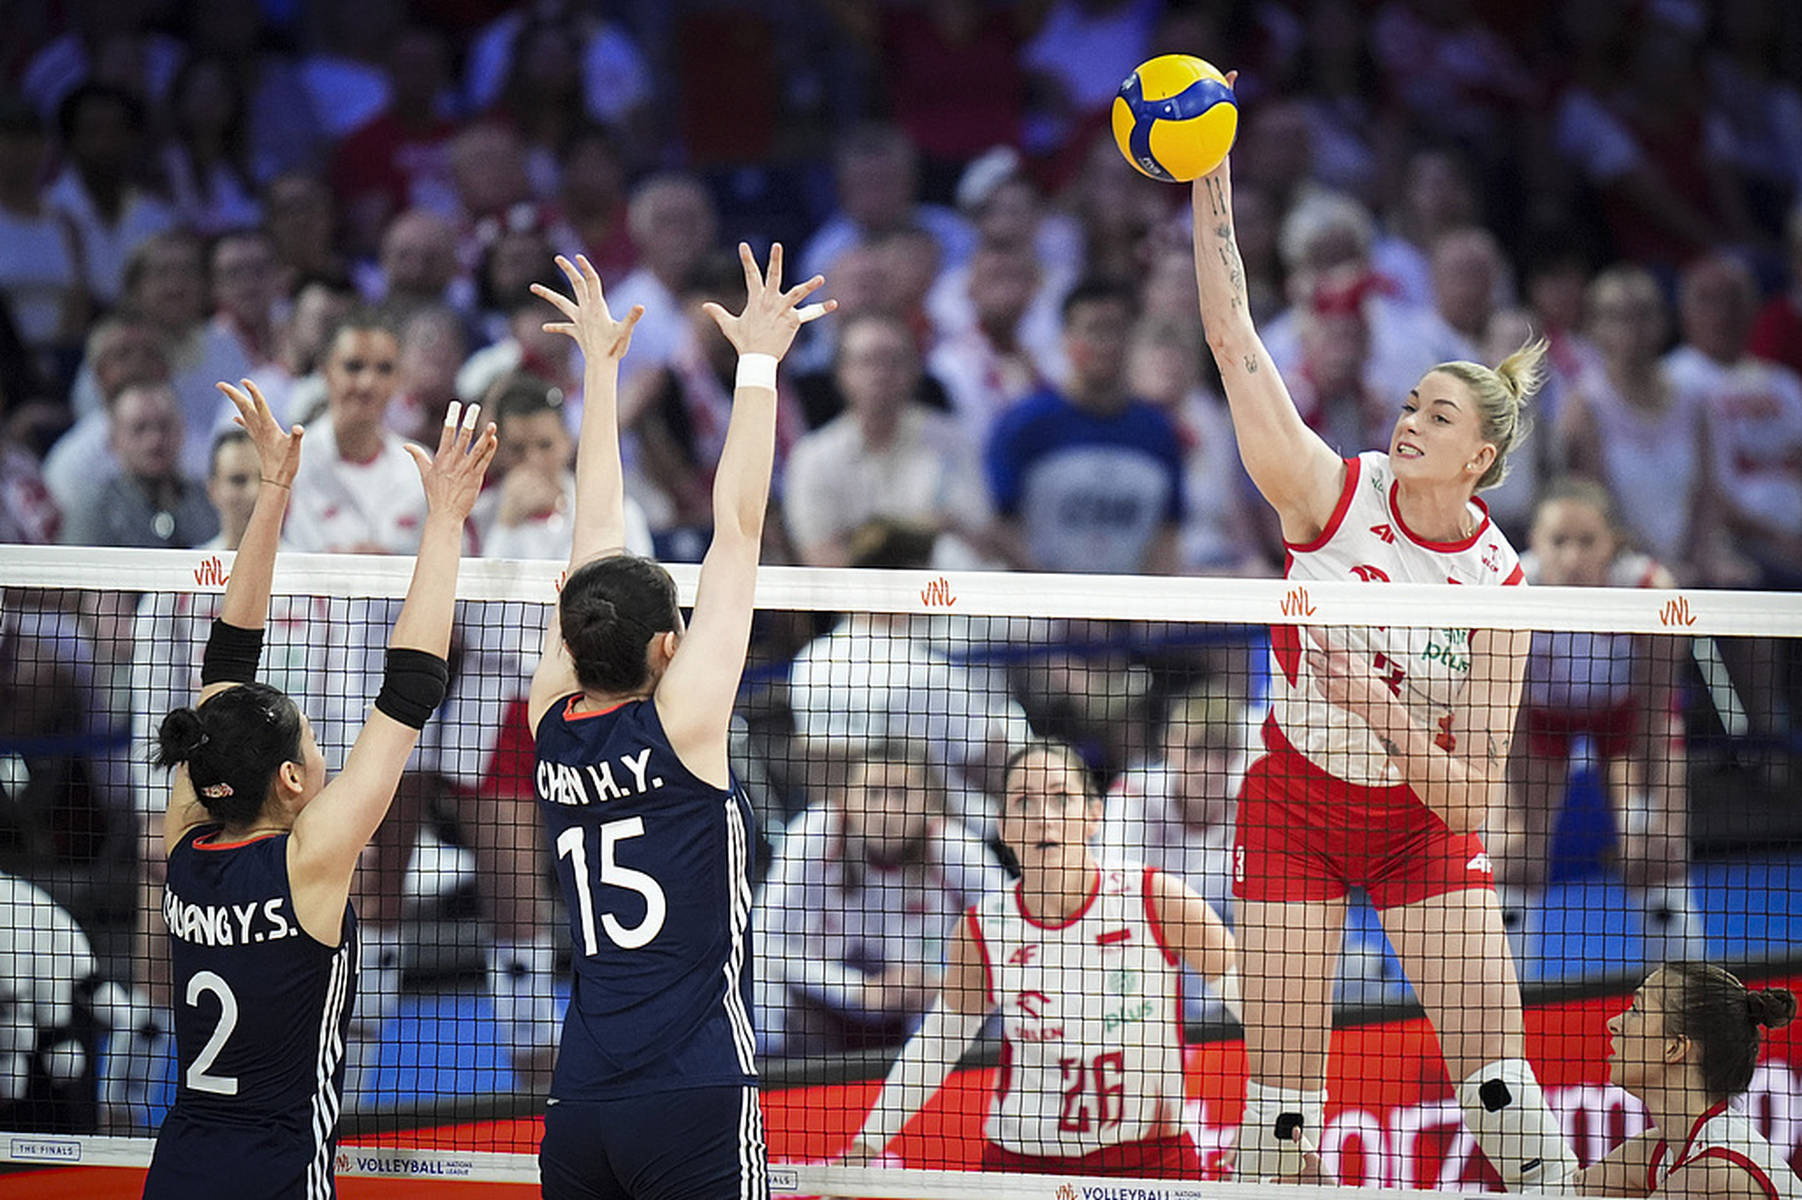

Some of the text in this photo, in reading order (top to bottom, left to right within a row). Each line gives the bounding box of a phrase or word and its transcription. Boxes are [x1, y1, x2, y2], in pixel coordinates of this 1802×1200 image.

[194, 555, 230, 586] VNL
[921, 576, 957, 606] VNL
[1281, 586, 1317, 616] VNL
[1660, 595, 1696, 626] VNL
[537, 748, 664, 805] CHEN H.Y.
[556, 815, 667, 957] 15
[232, 898, 298, 944] Y.S.
[186, 970, 239, 1095] 2
[1057, 1051, 1124, 1133] 26
[19, 1144, 74, 1156] THE FINALS
[356, 1157, 444, 1175] VOLLEYBALL
